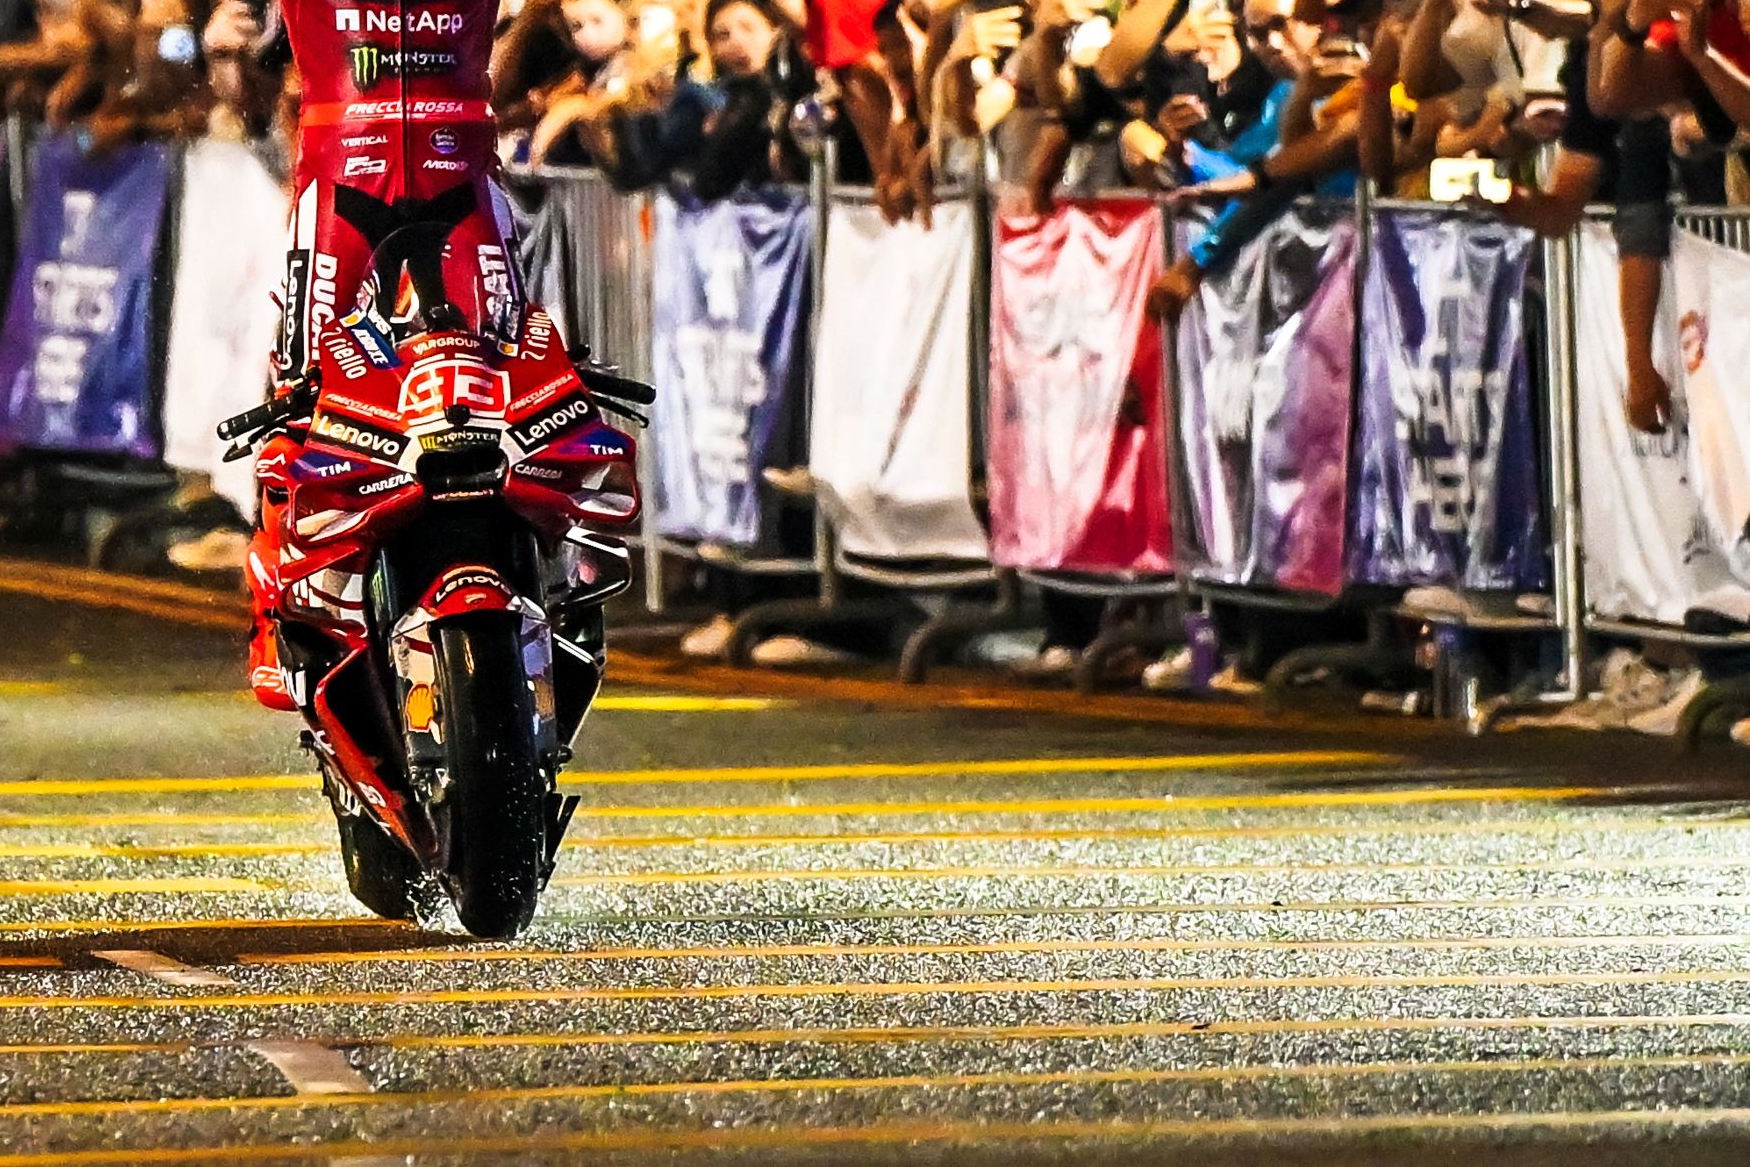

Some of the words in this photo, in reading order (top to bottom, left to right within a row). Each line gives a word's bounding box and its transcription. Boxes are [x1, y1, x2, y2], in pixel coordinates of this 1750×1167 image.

[366, 9, 463, 35] NetApp
[341, 135, 388, 147] VERTICAL
[524, 311, 553, 350] riello
[325, 338, 367, 380] riello
[316, 415, 400, 455] Lenovo
[514, 400, 588, 446] Lenovo
[590, 444, 624, 455] TIM
[319, 461, 351, 477] TIM
[359, 472, 414, 495] CARRERA
